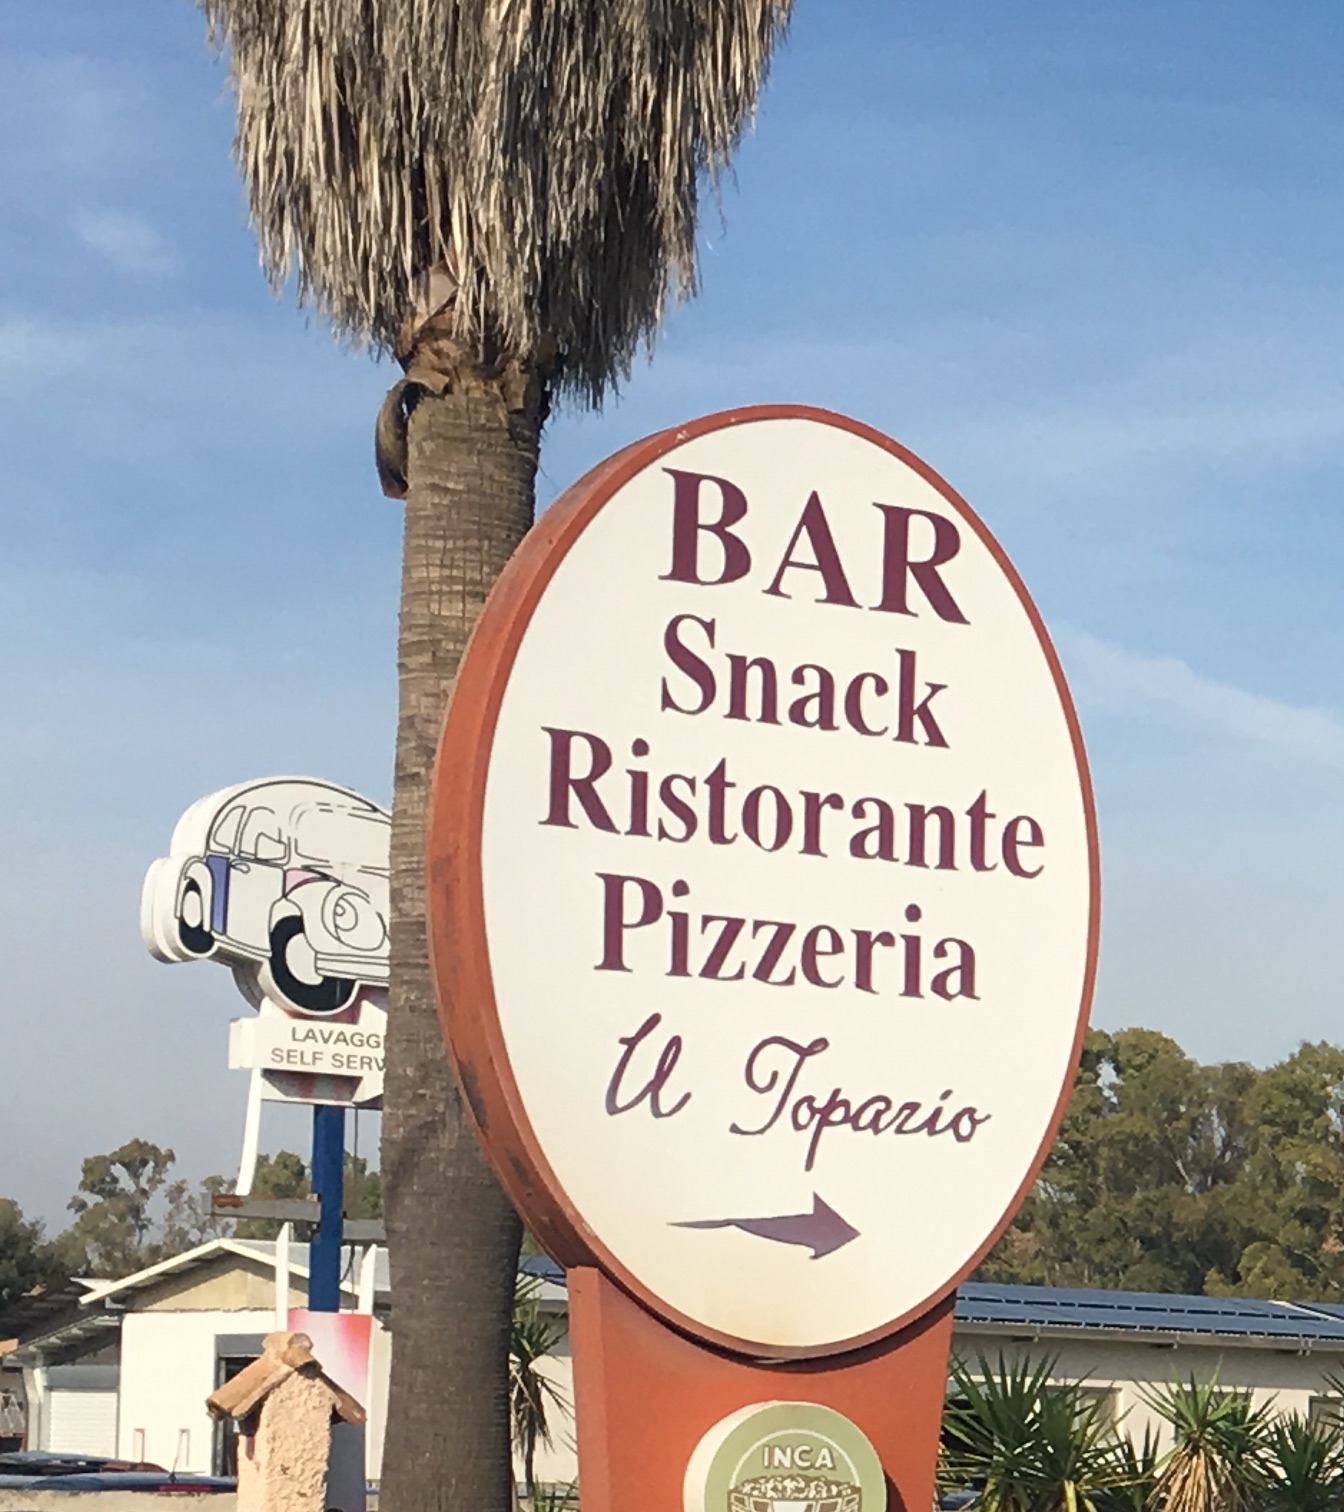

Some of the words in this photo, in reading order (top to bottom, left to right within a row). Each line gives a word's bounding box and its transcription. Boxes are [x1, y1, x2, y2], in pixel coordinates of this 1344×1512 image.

[658, 467, 971, 625] BAR
[661, 613, 950, 749] Snack
[538, 726, 1046, 879] Ristorante
[594, 872, 981, 1002] Pizzeria
[270, 1047, 324, 1066] SELF
[331, 1053, 386, 1072] SERV
[291, 1026, 382, 1049] LAVAGG
[729, 1035, 991, 1172] Topazio
[762, 1445, 837, 1471] INCA
